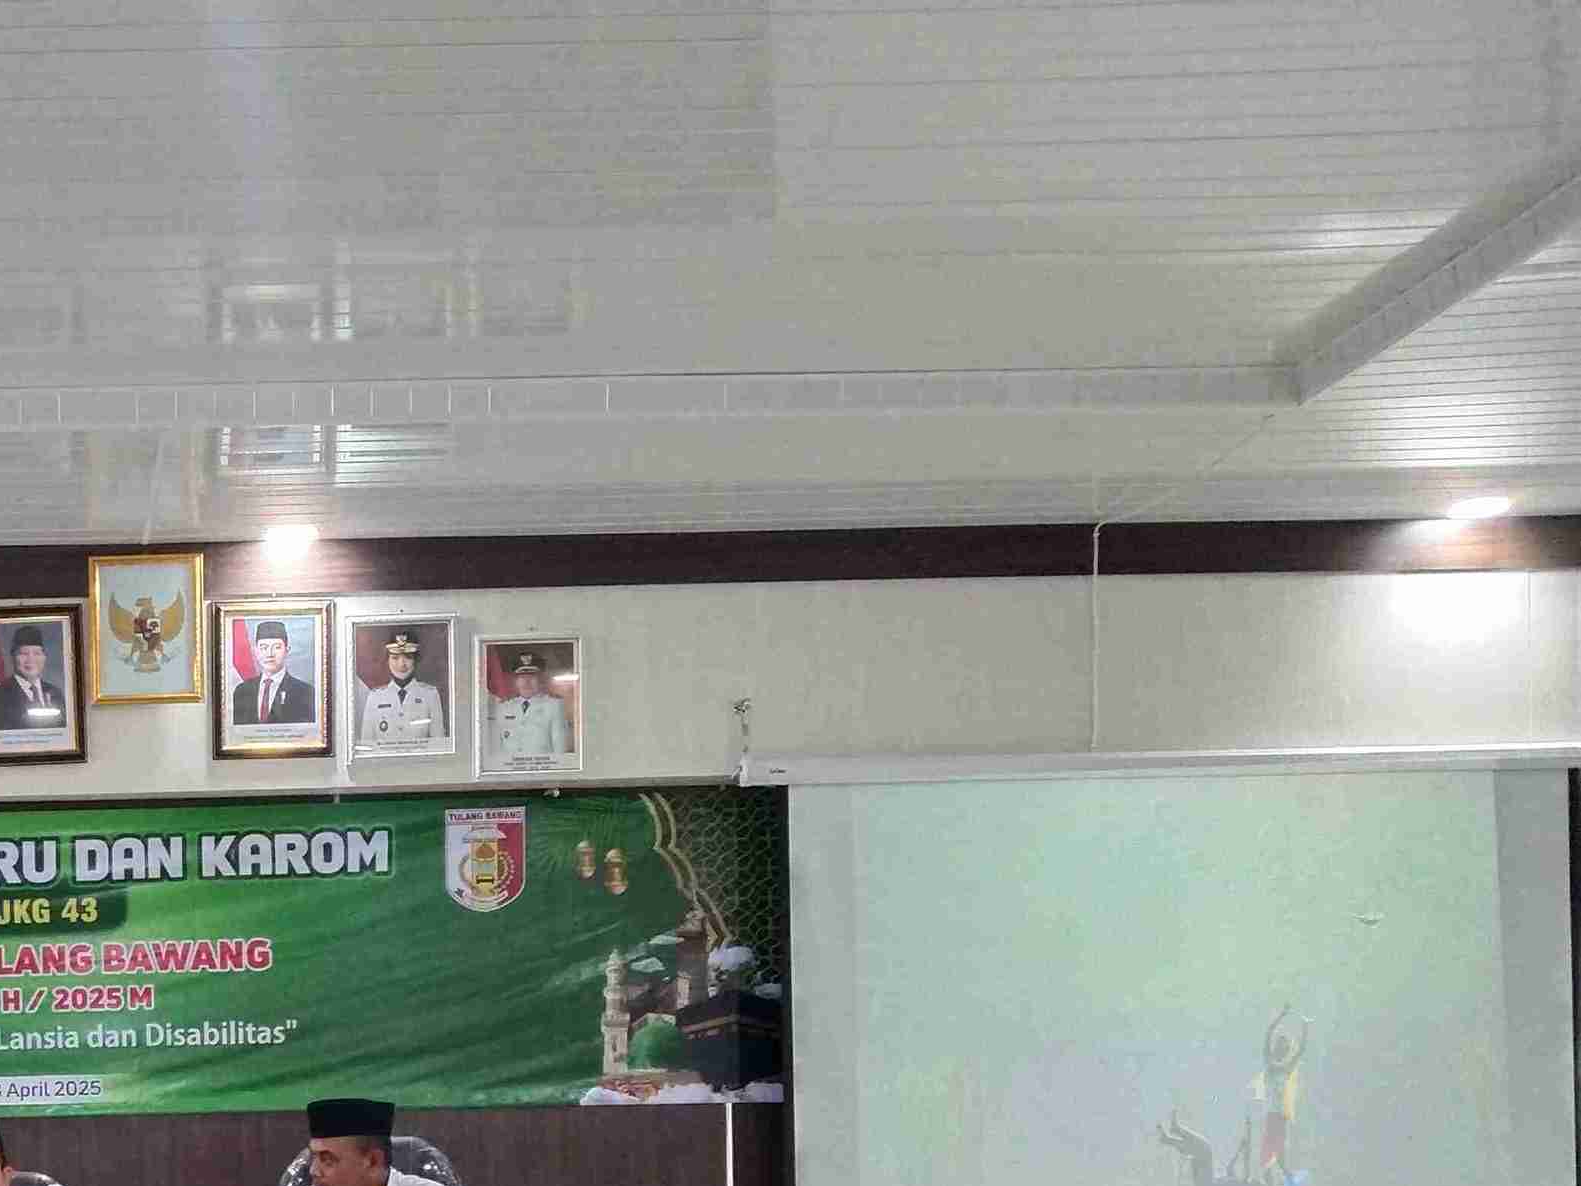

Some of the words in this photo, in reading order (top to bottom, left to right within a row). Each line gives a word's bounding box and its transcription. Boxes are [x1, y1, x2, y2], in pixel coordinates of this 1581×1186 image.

[75, 836, 183, 881] DAN
[201, 831, 389, 877] KAROM
[61, 897, 99, 922] 43
[101, 938, 273, 974] BAWANG
[1, 987, 21, 1012] H
[27, 986, 46, 1014] /
[51, 984, 123, 1011] 2025
[127, 984, 154, 1009] M
[87, 1024, 137, 1048] dan
[146, 1018, 298, 1046] Disabilitas"
[7, 1081, 51, 1102] April
[54, 1080, 101, 1097] 2025
